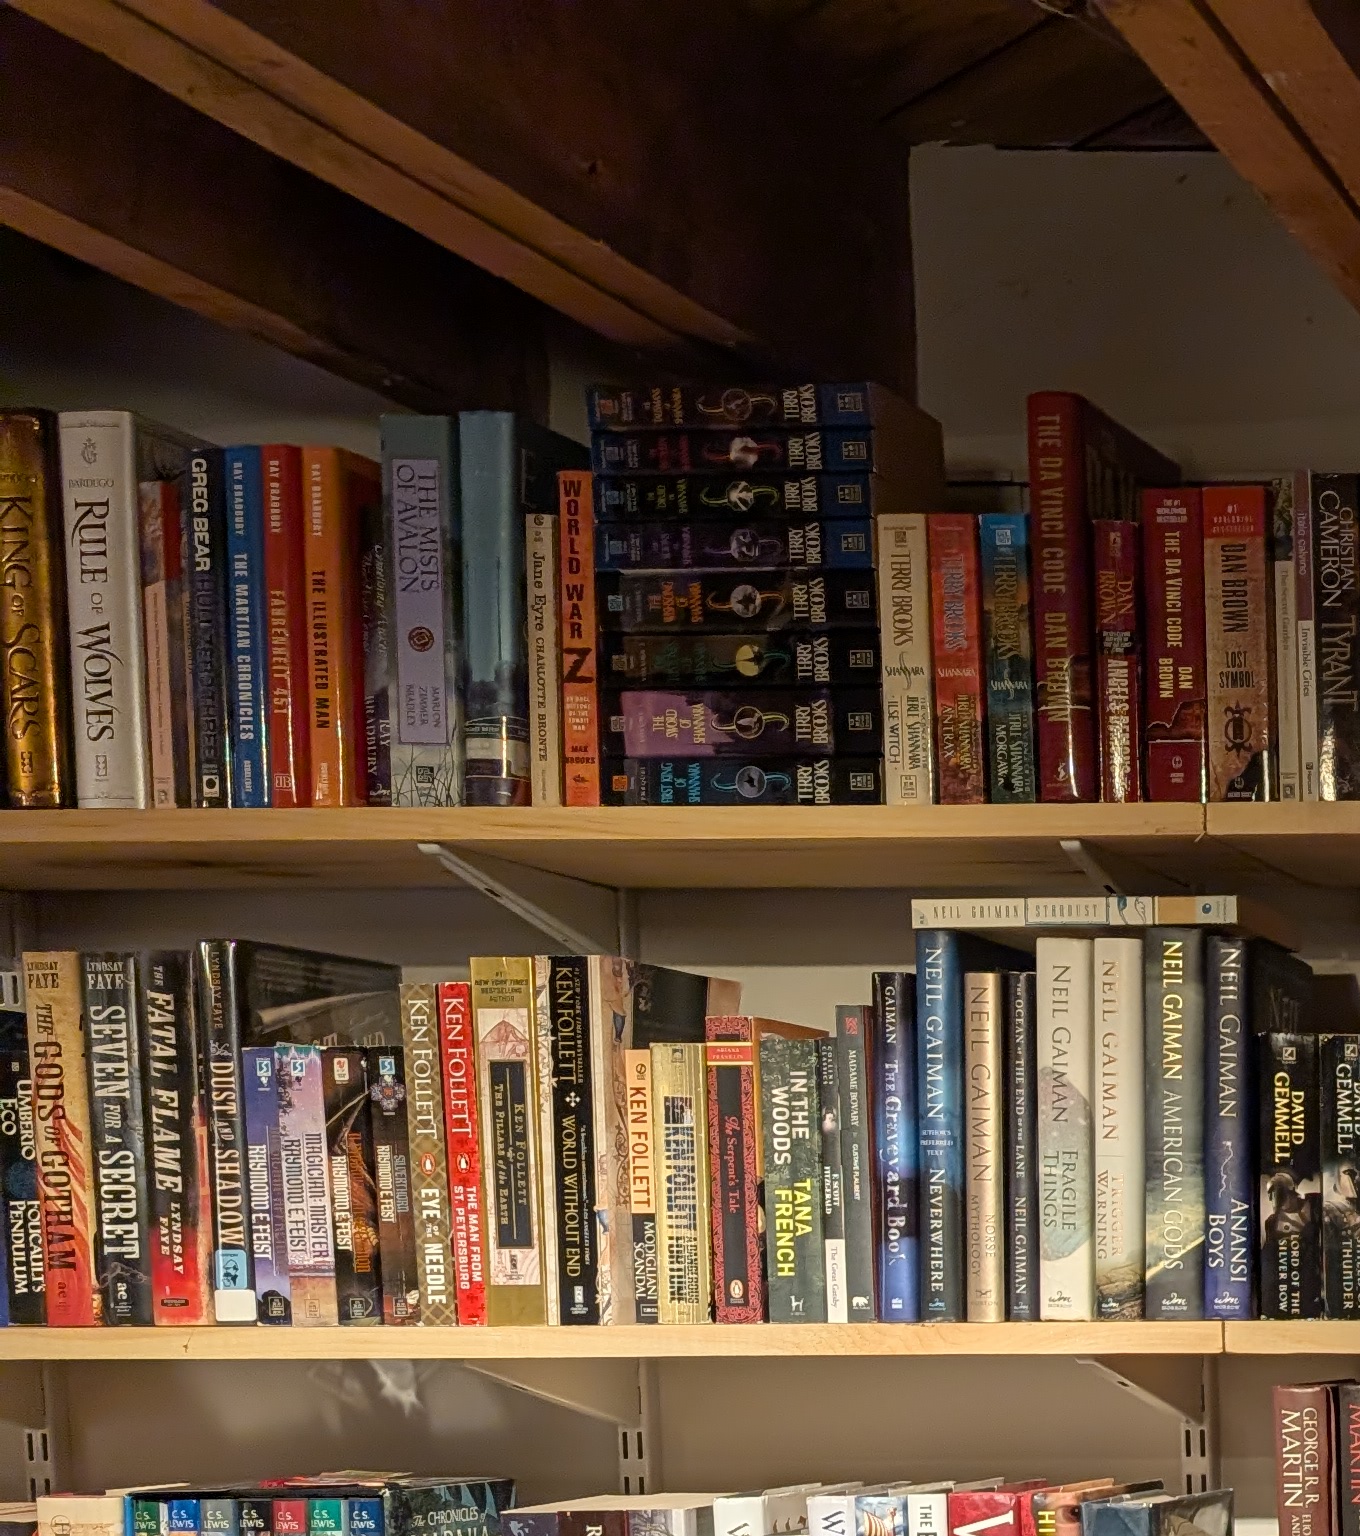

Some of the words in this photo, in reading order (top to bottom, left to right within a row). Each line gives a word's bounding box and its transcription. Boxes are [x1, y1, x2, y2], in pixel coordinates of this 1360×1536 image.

[70, 498, 110, 584] RULE
[563, 480, 582, 575] WORLD
[1164, 531, 1180, 552] THE
[233, 553, 247, 581] THE
[1164, 556, 1181, 576] DA
[90, 593, 104, 615] OF
[234, 587, 249, 648] MARTIAN
[565, 584, 584, 639] WAR
[1164, 579, 1181, 615] VINCI
[1164, 620, 1182, 648] CODE
[76, 623, 124, 742] WOLVES
[563, 648, 592, 683] Z
[236, 655, 253, 741] CHRONICLES
[925, 948, 943, 1008] NEIL
[443, 999, 465, 1038] KEN
[90, 1005, 126, 1099] SEVEN
[926, 1016, 944, 1121] GAIMAN
[102, 1102, 121, 1125] FOR
[447, 1046, 472, 1138] FOLLETT
[104, 1134, 112, 1142] A
[1164, 1089, 1183, 1202] AMERICAN
[99, 1150, 140, 1258] SECRET
[775, 1188, 795, 1277] FRENCH
[792, 1179, 813, 1237] TANA
[929, 1169, 945, 1293] NEVERWHERE
[1163, 1208, 1183, 1270] GODS
[1208, 1214, 1225, 1268] BOYS
[1231, 1199, 1247, 1282] ANANSI
[919, 1505, 933, 1527] THE
